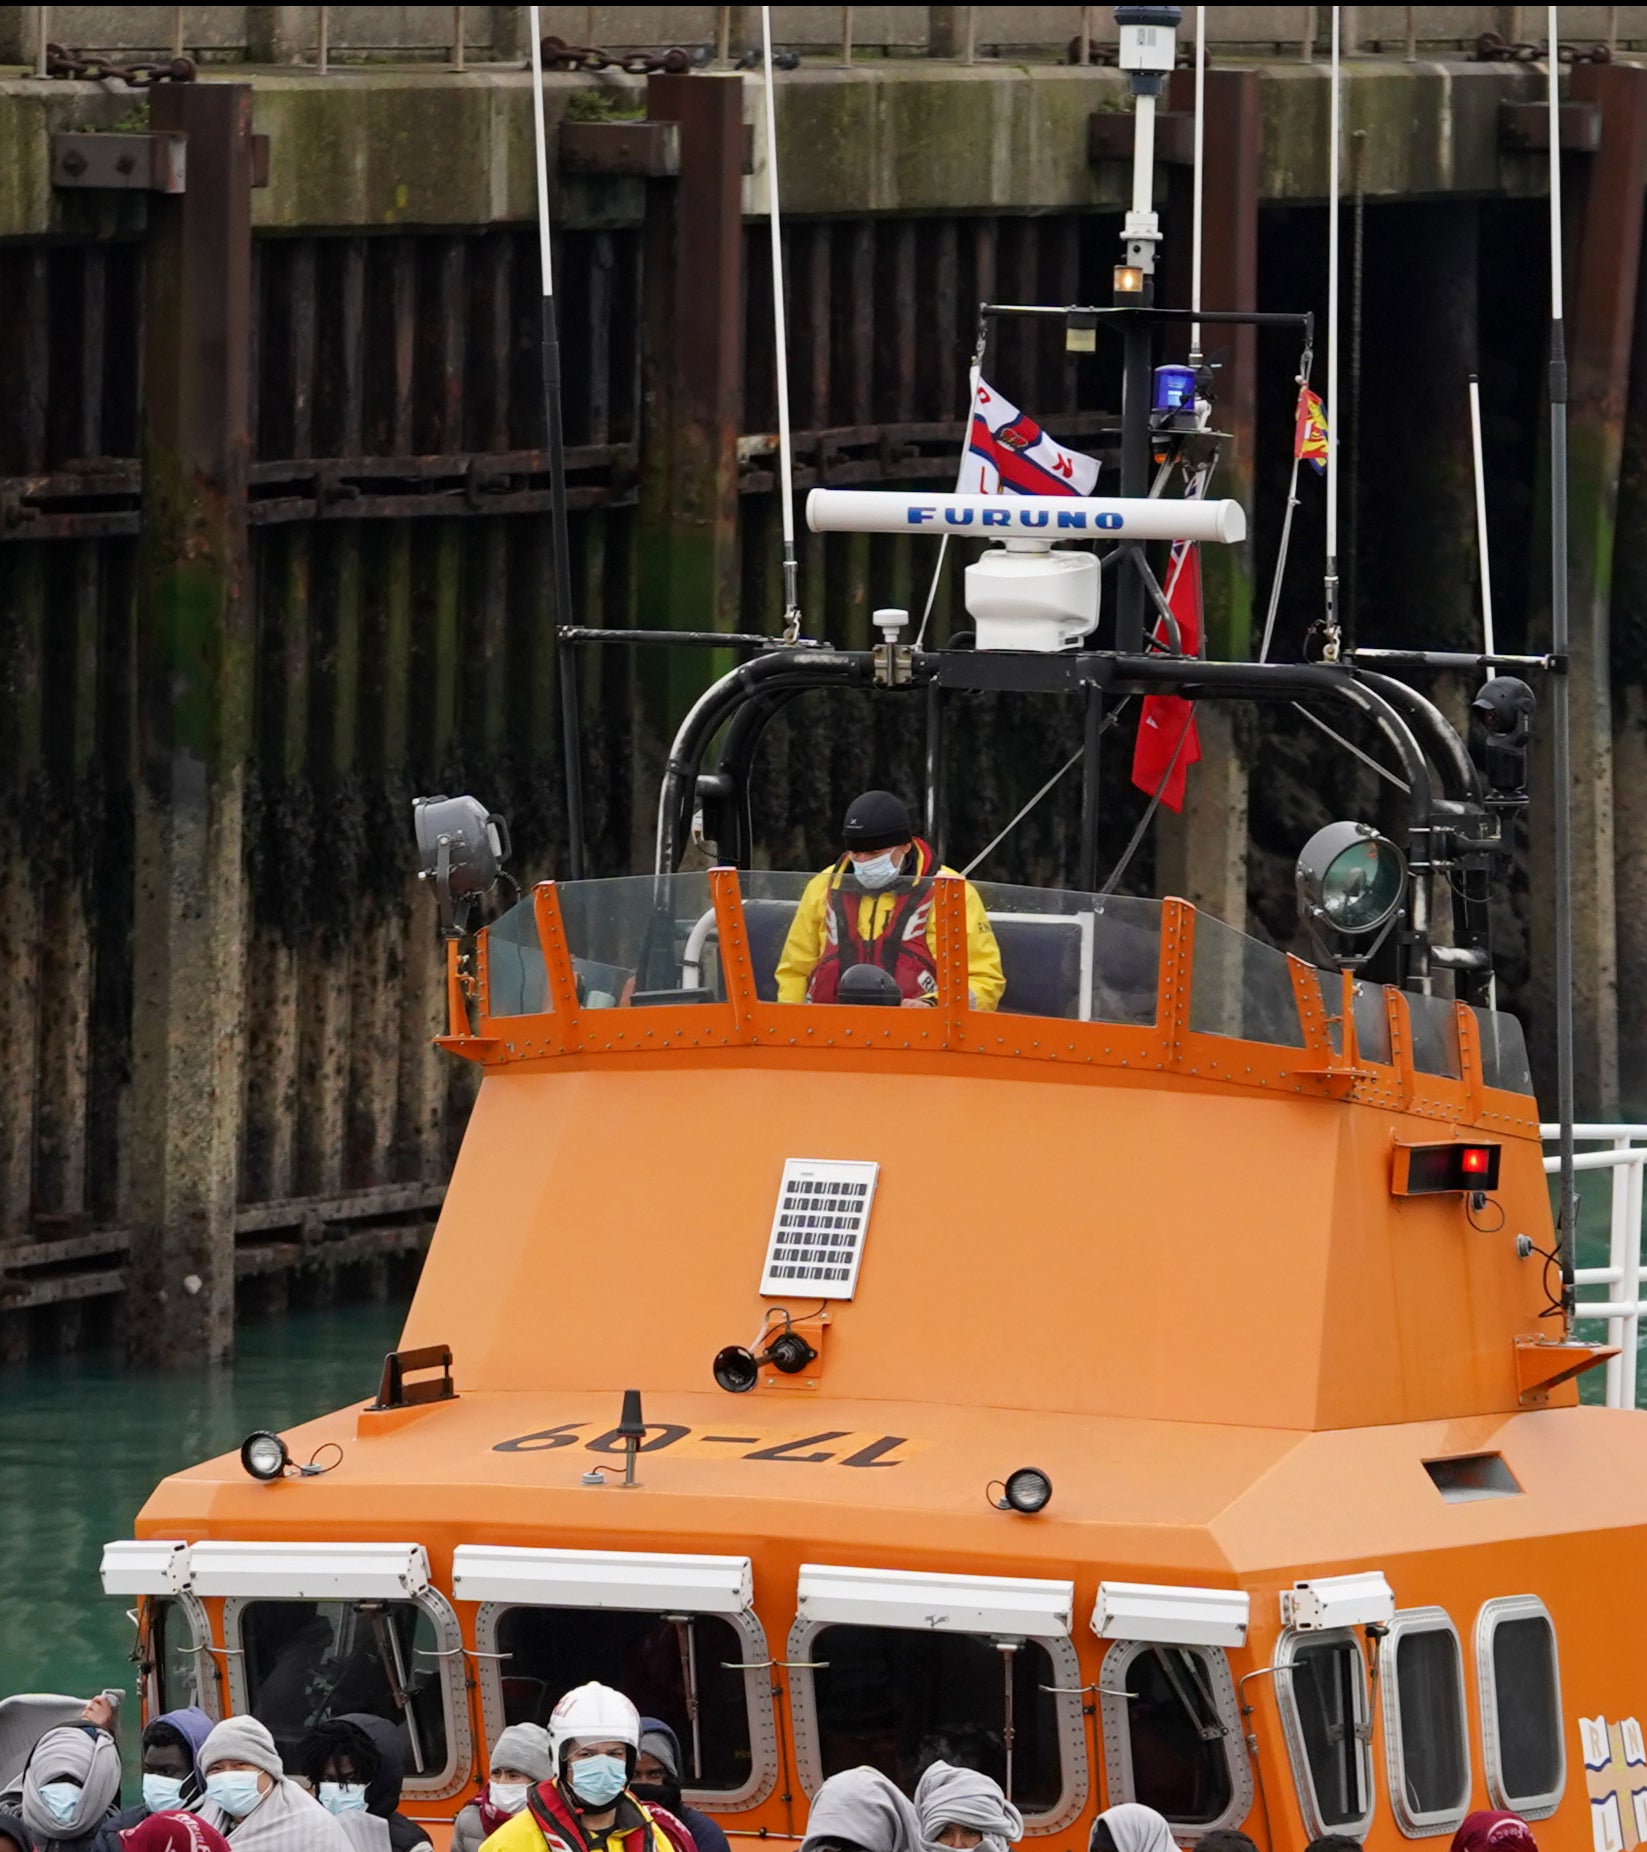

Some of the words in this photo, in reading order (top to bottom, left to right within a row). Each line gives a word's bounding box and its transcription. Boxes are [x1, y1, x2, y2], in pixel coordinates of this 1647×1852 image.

[907, 506, 1125, 530] FURUNO
[491, 1421, 909, 1468] 17-09
[1588, 1723, 1603, 1760] R
[1627, 1722, 1640, 1755] N
[1601, 1811, 1615, 1852] L
